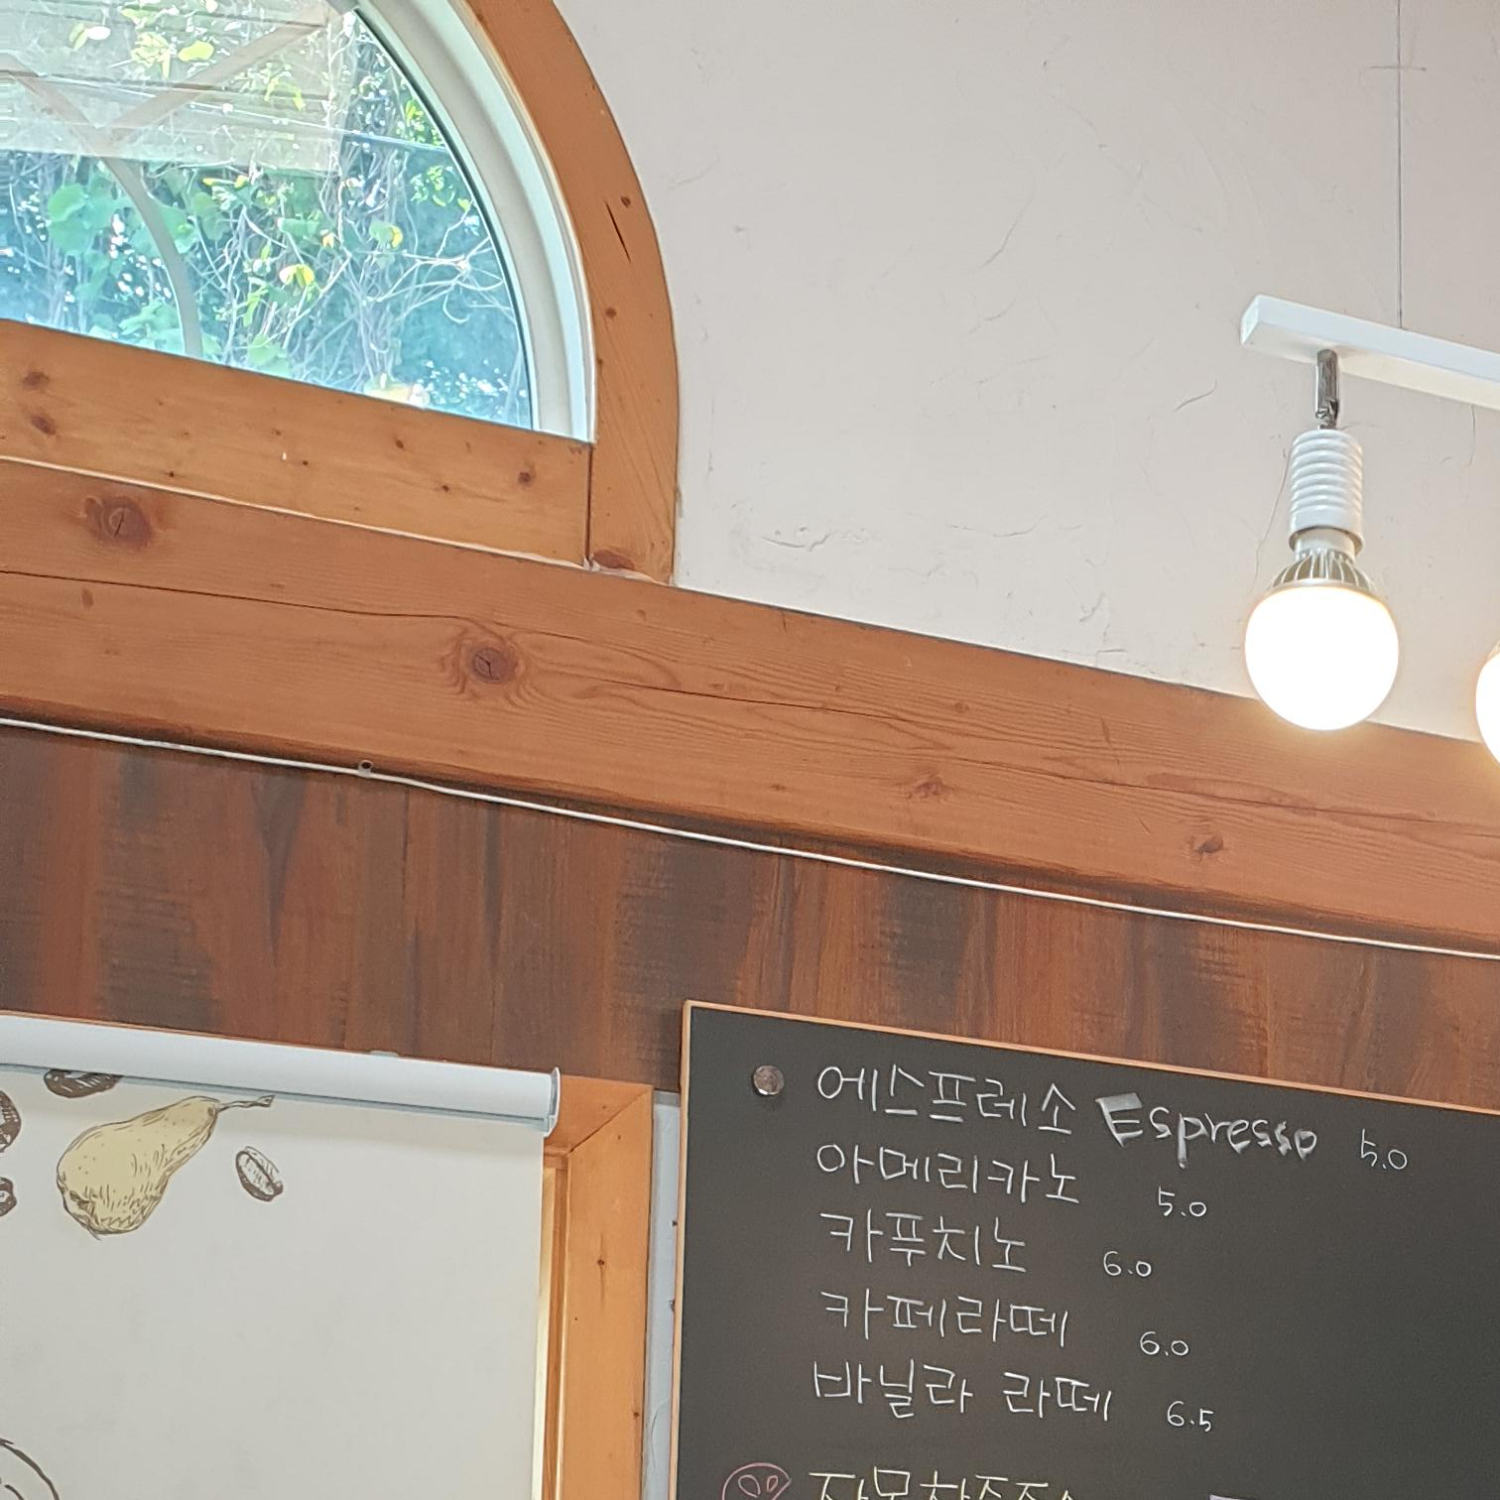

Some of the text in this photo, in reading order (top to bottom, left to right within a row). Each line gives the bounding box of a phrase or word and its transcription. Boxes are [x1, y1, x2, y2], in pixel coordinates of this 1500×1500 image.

[817, 1063, 1076, 1135] 에스프레소
[1096, 1092, 1408, 1170] Espresso 5.0
[816, 1143, 1207, 1218] 아메리카노 5.0
[819, 1208, 1152, 1278] 카푸치노 6.0
[820, 1287, 1189, 1357] 카페라떼 6.0
[813, 1358, 1214, 1433] 바닐라 라떼 6.5
